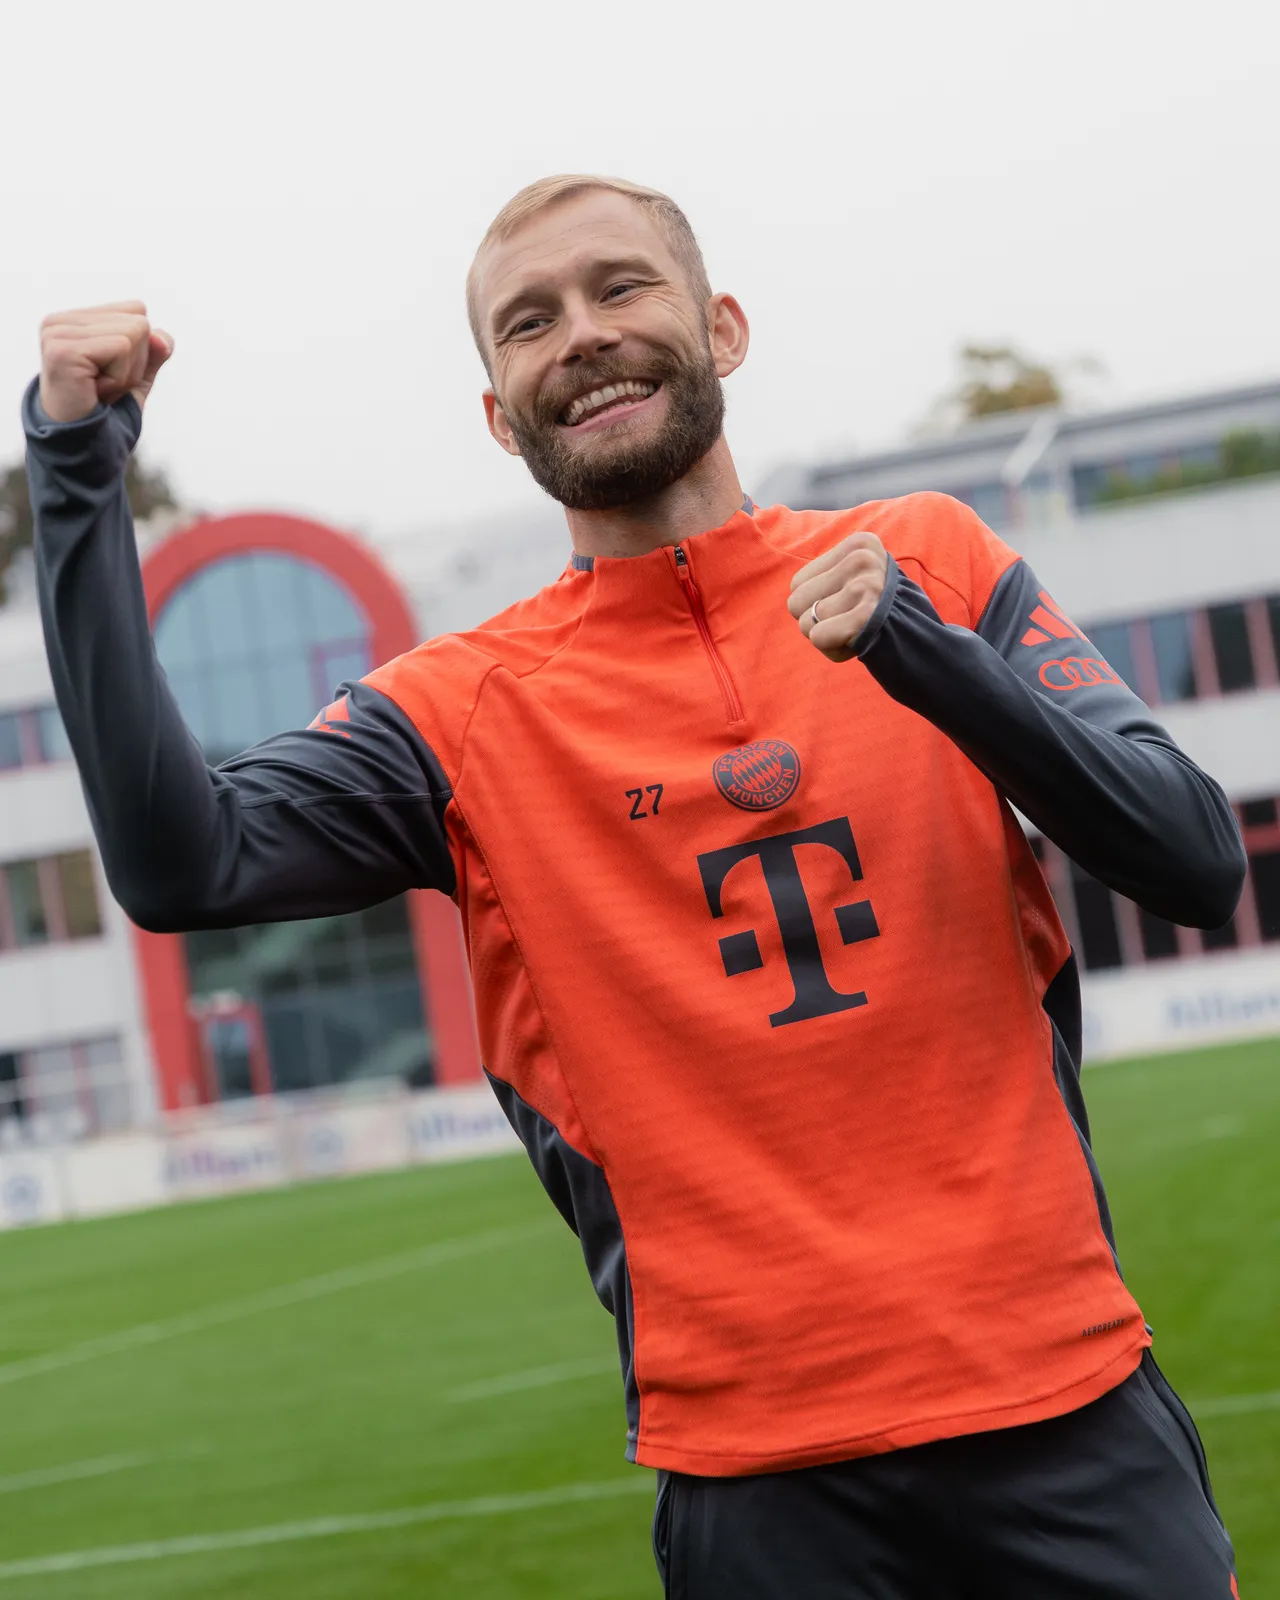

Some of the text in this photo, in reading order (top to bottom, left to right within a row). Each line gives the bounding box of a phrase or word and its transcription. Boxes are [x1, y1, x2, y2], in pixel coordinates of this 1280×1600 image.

[719, 743, 788, 772] FC BAYERN
[625, 783, 664, 821] 27
[727, 768, 795, 805] MÜNCHEN
[697, 816, 868, 1028] T
